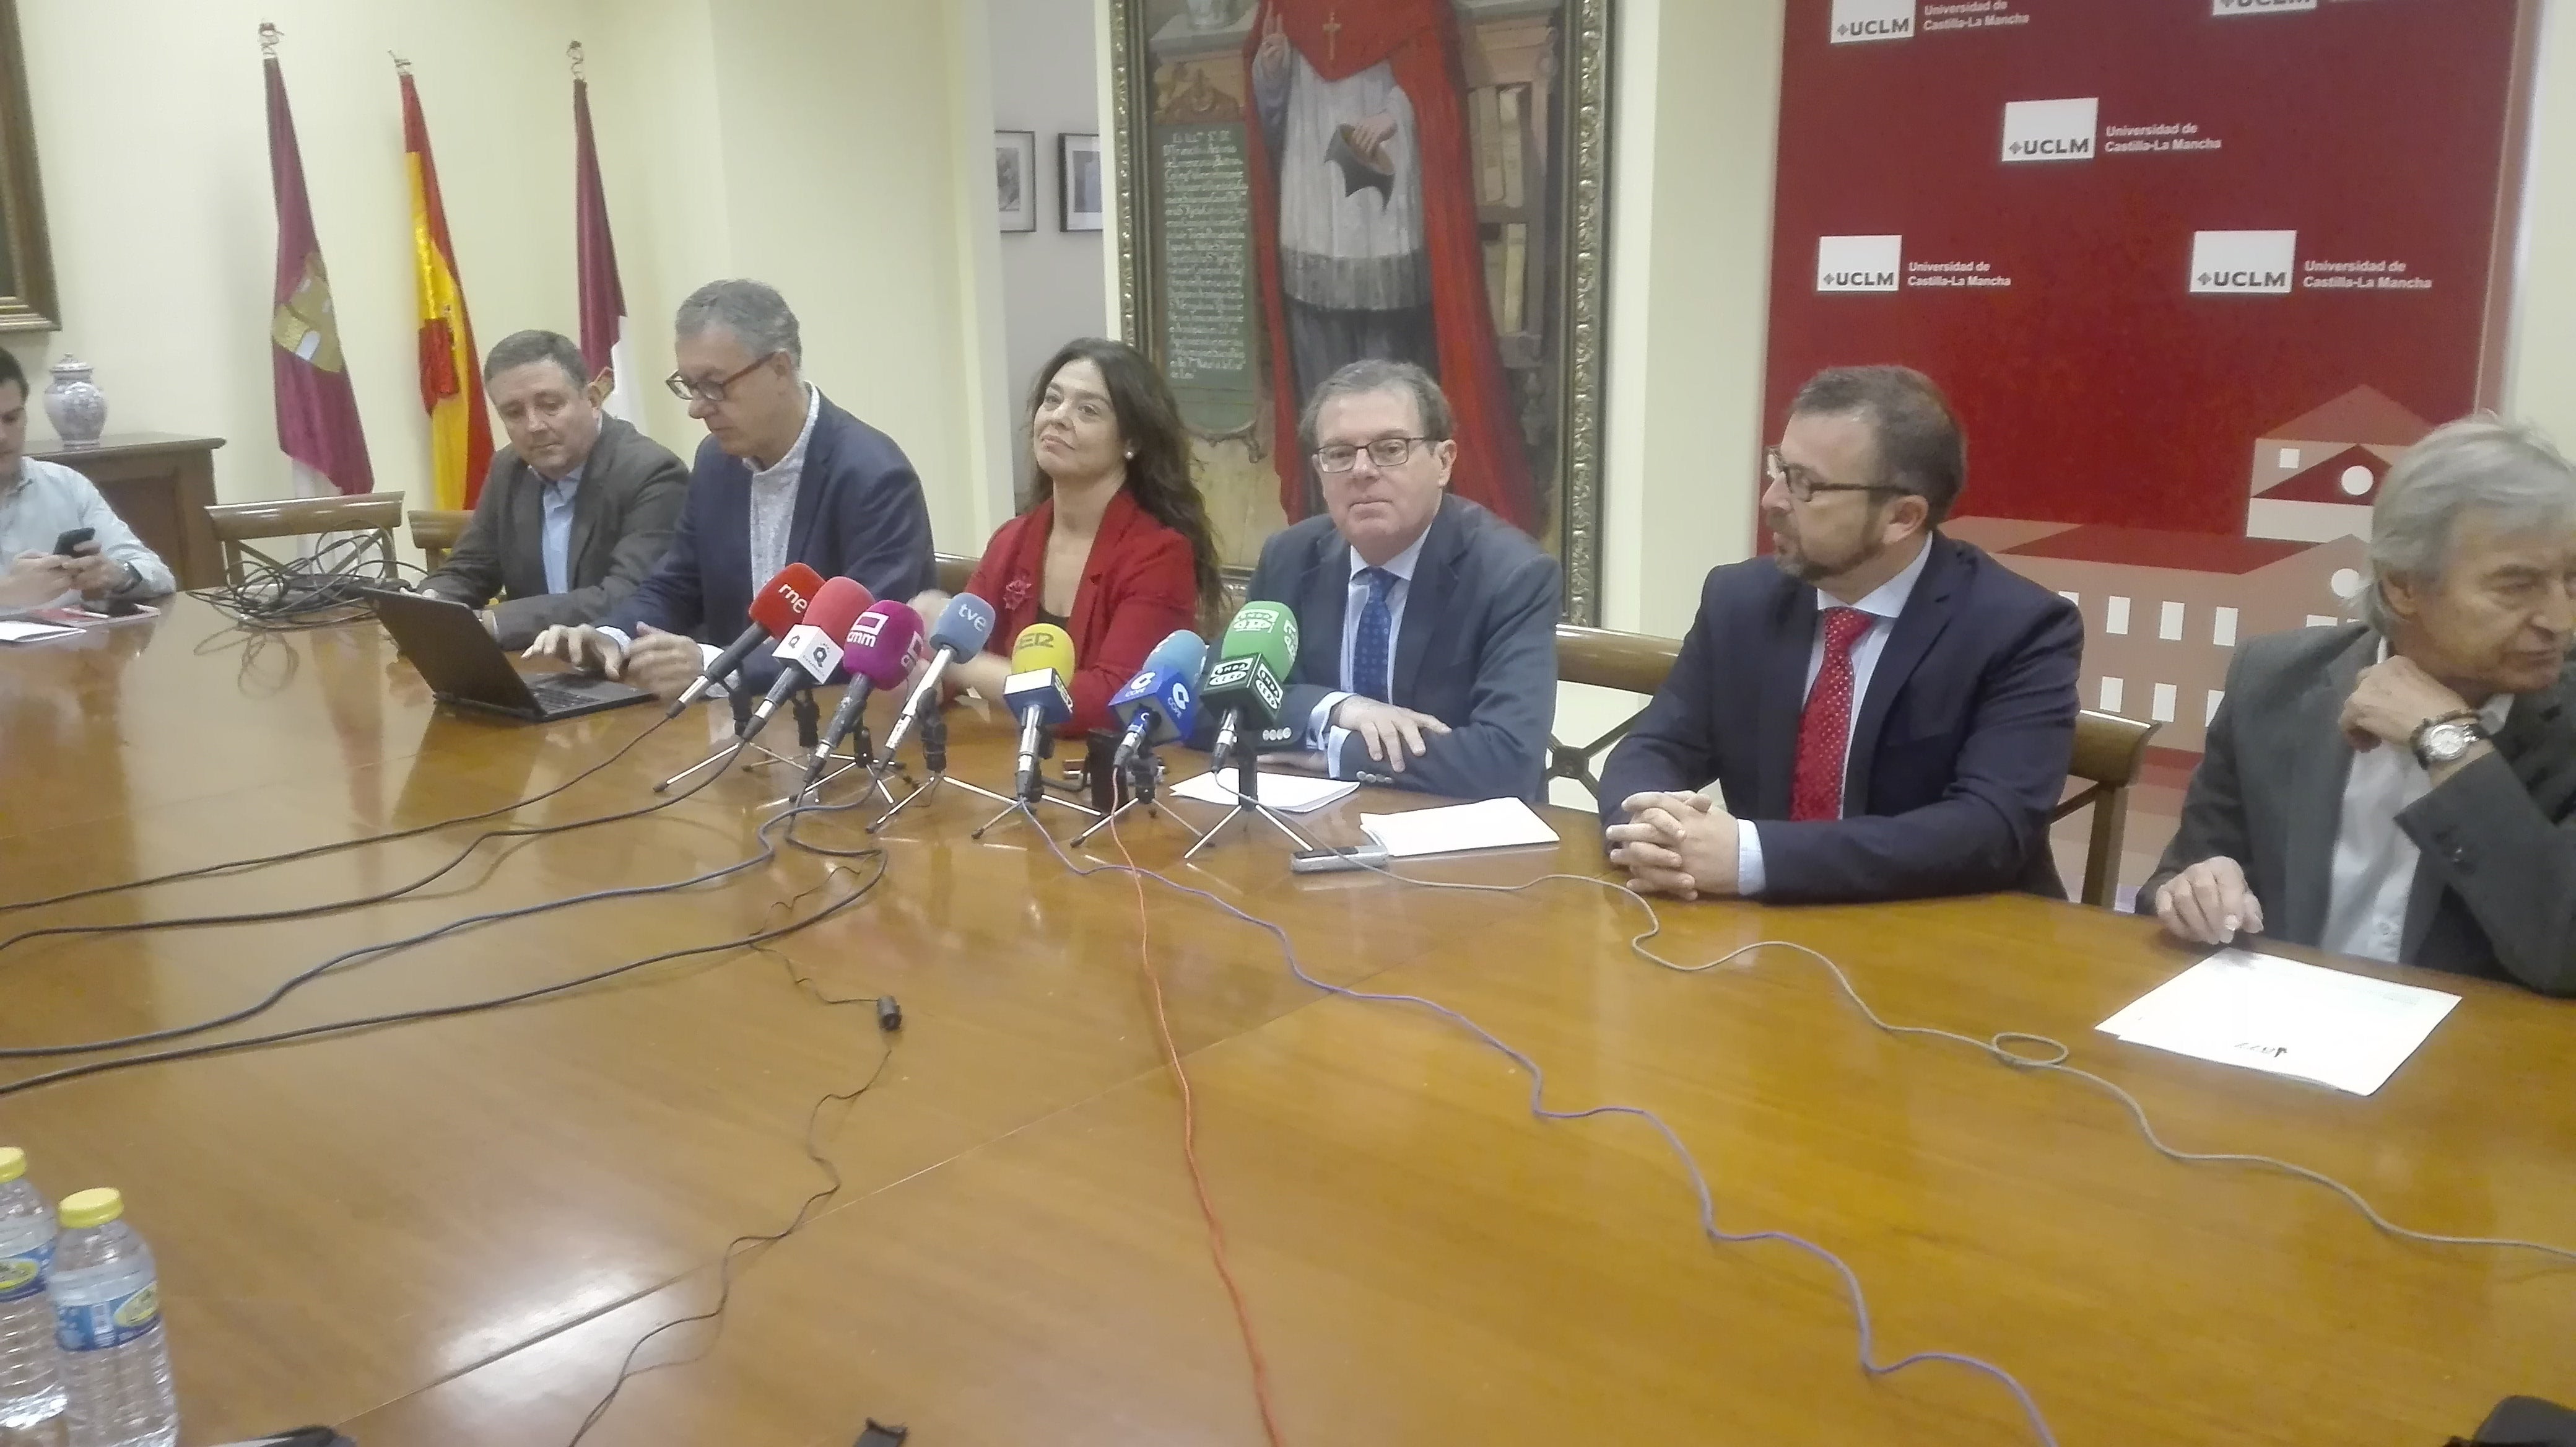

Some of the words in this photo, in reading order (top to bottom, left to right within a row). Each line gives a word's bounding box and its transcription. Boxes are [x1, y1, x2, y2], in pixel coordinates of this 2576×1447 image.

[1924, 1, 1991, 15] Universidad
[1993, 1, 2009, 10] de
[1985, 12, 2030, 25] Mancha
[1850, 17, 1909, 35] UCLM
[2106, 123, 2179, 137] Universidad
[2182, 123, 2198, 134] de
[2024, 138, 2090, 155] UCLM
[2105, 139, 2170, 152] Castilla-La
[2172, 138, 2222, 151] Mancha
[1908, 261, 1973, 272] Universidad
[1975, 261, 1991, 271] de
[2304, 260, 2386, 272] Universidad
[2388, 261, 2406, 272] de
[1836, 272, 1894, 286] UCLM
[1907, 276, 1965, 286] Castilla-La
[1967, 276, 2011, 286] Mancha
[2214, 271, 2287, 287] UCLM
[2303, 276, 2374, 288] Castilla-La
[2377, 277, 2432, 289] Mancha
[778, 584, 808, 613] rne
[959, 604, 986, 632] tve
[1215, 662, 1248, 675] ONDA
[1260, 670, 1279, 698] ONDA
